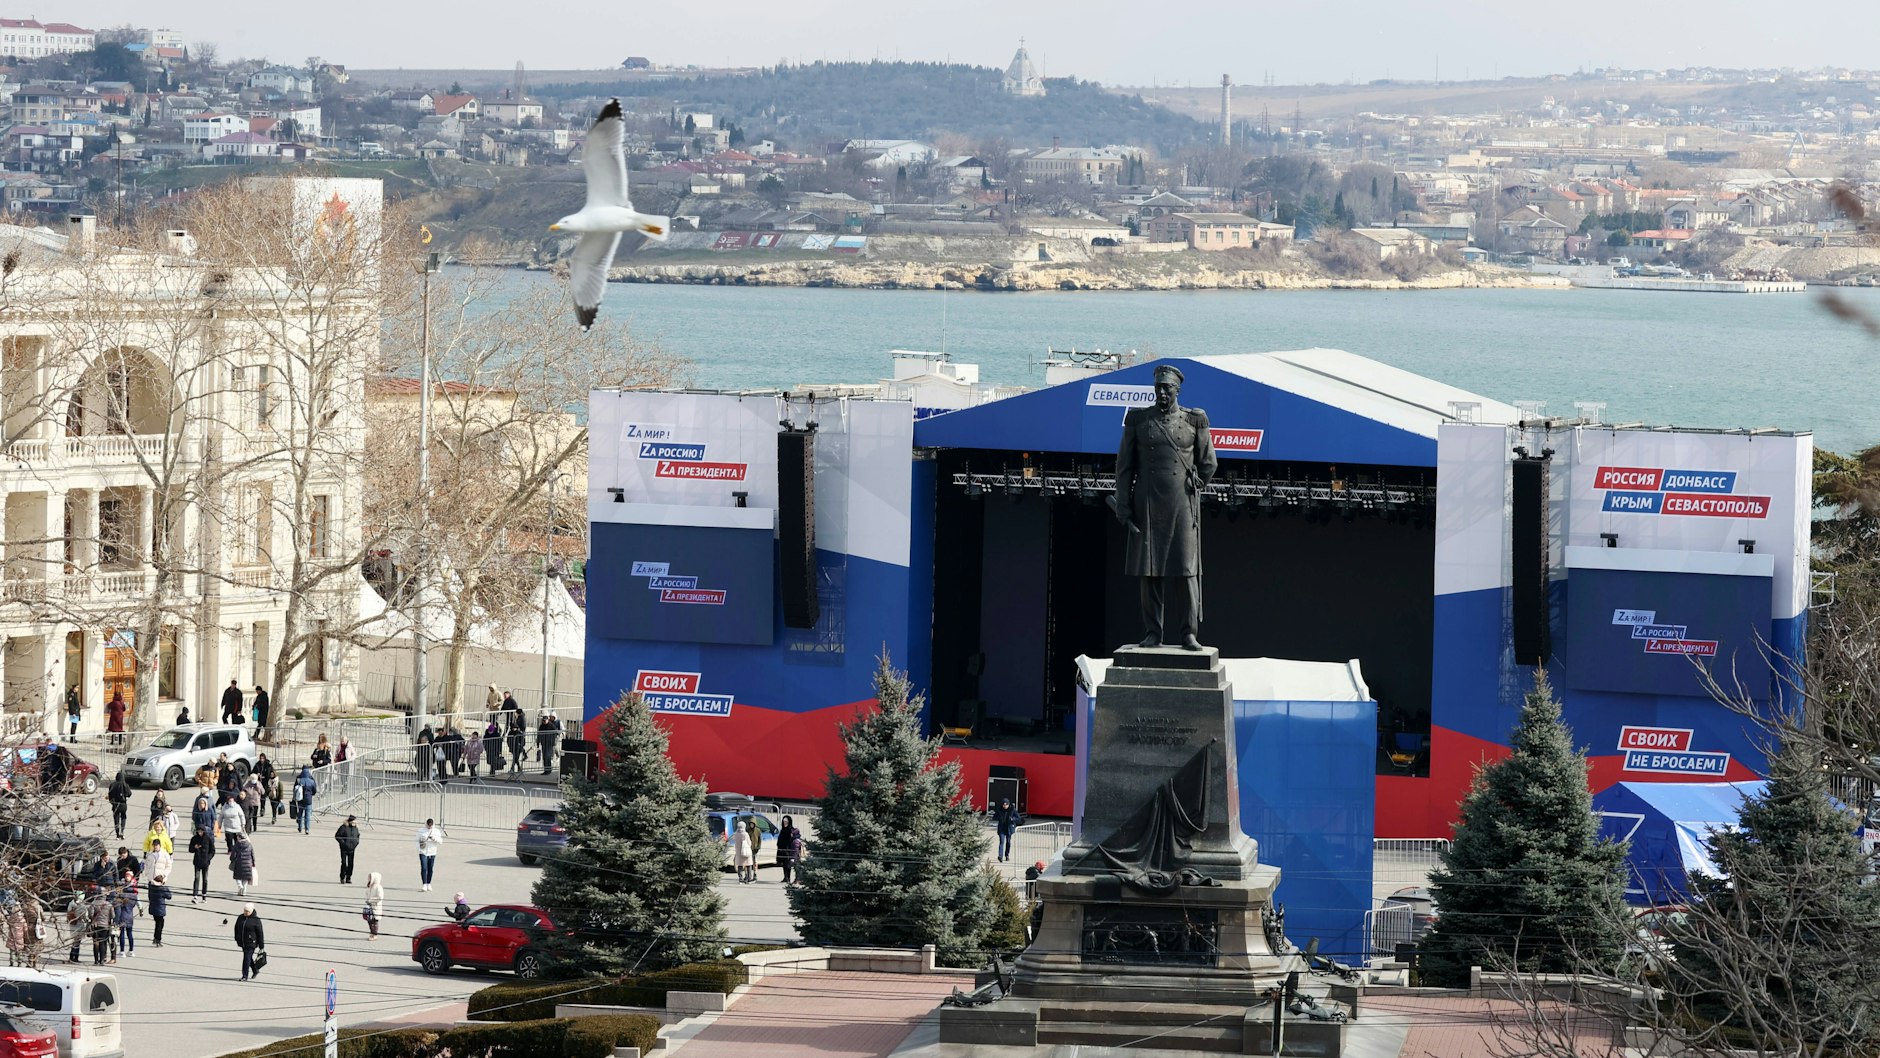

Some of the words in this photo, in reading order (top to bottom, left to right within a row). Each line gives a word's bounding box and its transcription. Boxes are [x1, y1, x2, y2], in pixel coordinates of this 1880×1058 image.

[1093, 390, 1156, 402] СЕВАСТОПО
[644, 430, 665, 439] МИР
[1214, 434, 1257, 446] ГАВАНИ!
[658, 448, 697, 458] РОССИЮ
[677, 466, 737, 478] ПРЕЗИДЕНТА
[1603, 472, 1655, 485] РОССИЯ
[1666, 475, 1726, 488] ДОНБАСС
[1612, 496, 1652, 509] КРЫМ
[1667, 499, 1763, 514] СЕВАСТОПОЛЬ
[643, 676, 688, 690] СВОИХ
[647, 697, 662, 708] НЕ
[664, 698, 721, 712] БРОСАЕМ
[1628, 732, 1678, 747] СВОИХ
[1631, 755, 1649, 767] НЕ
[1652, 756, 1715, 770] БРОСАЕМ
